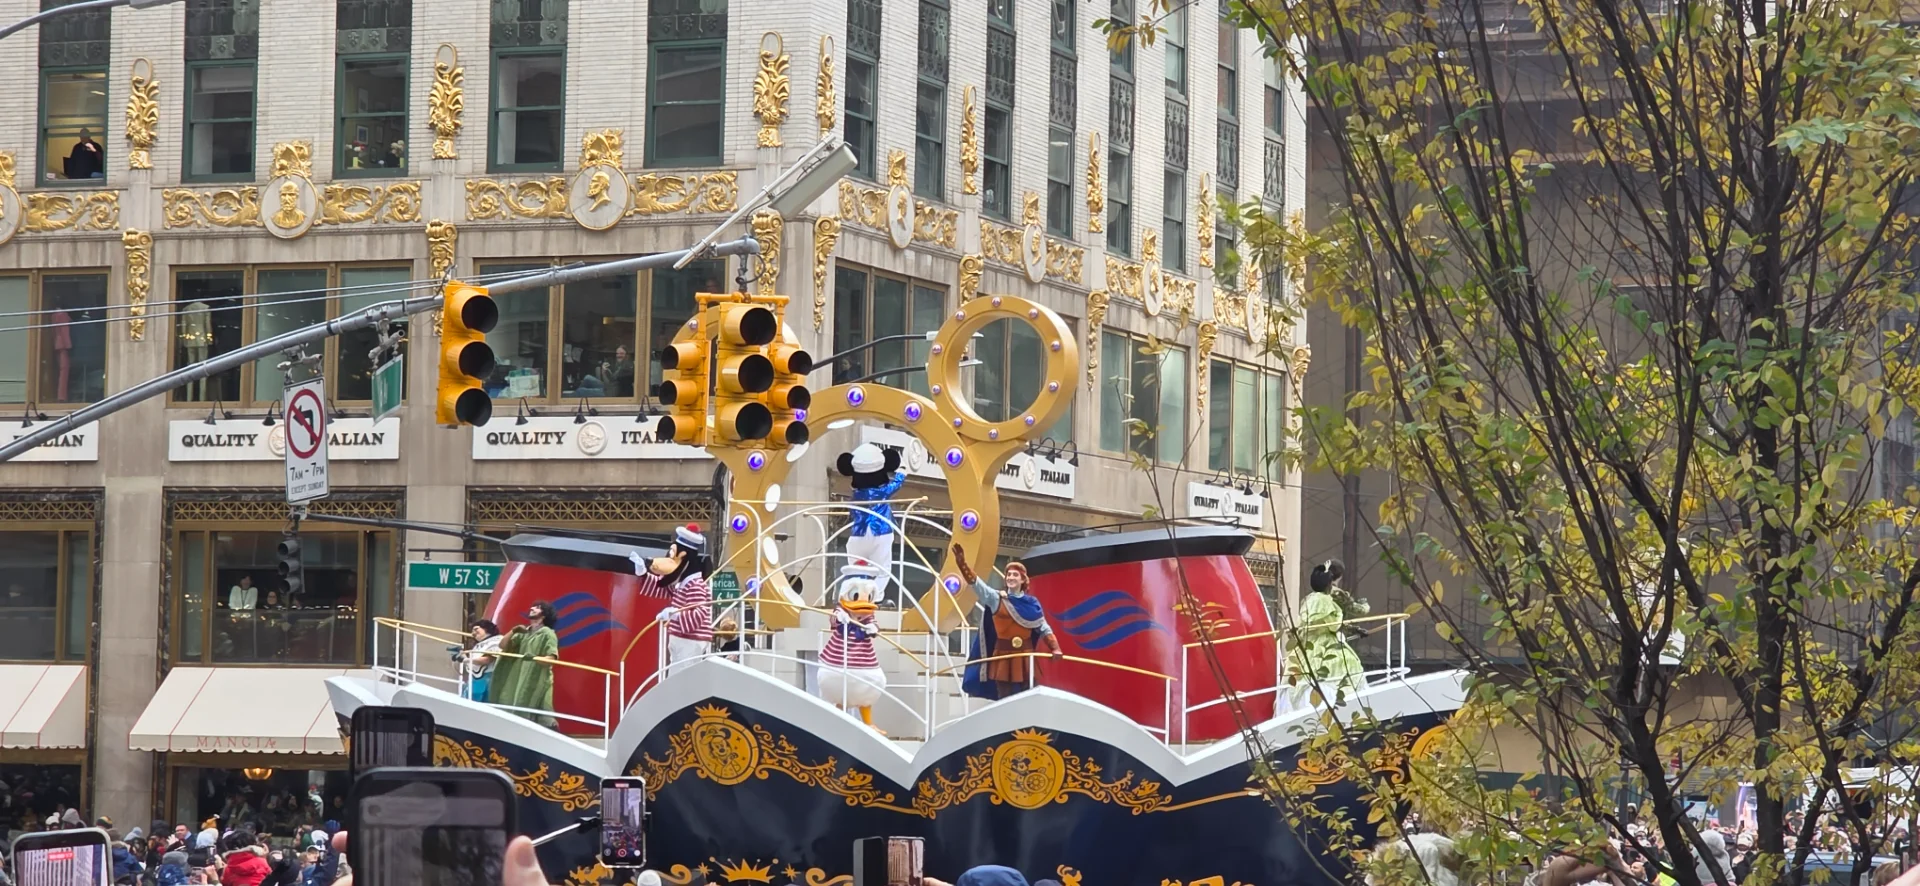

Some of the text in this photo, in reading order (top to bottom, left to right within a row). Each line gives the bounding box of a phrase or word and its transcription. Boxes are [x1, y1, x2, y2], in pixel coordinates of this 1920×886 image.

[181, 432, 385, 447] QUALITY ALIAN
[486, 431, 676, 445] QUALITY ITAL
[290, 466, 303, 481] 7AM
[310, 462, 324, 476] 7PM
[1040, 469, 1070, 484] ITALIAN
[291, 481, 324, 494] EXCEPT SUNDAY
[1194, 495, 1259, 515] QUALITY ITALIAN
[439, 568, 490, 586] W 57 St
[713, 579, 735, 588] ericas
[717, 592, 722, 605] 6
